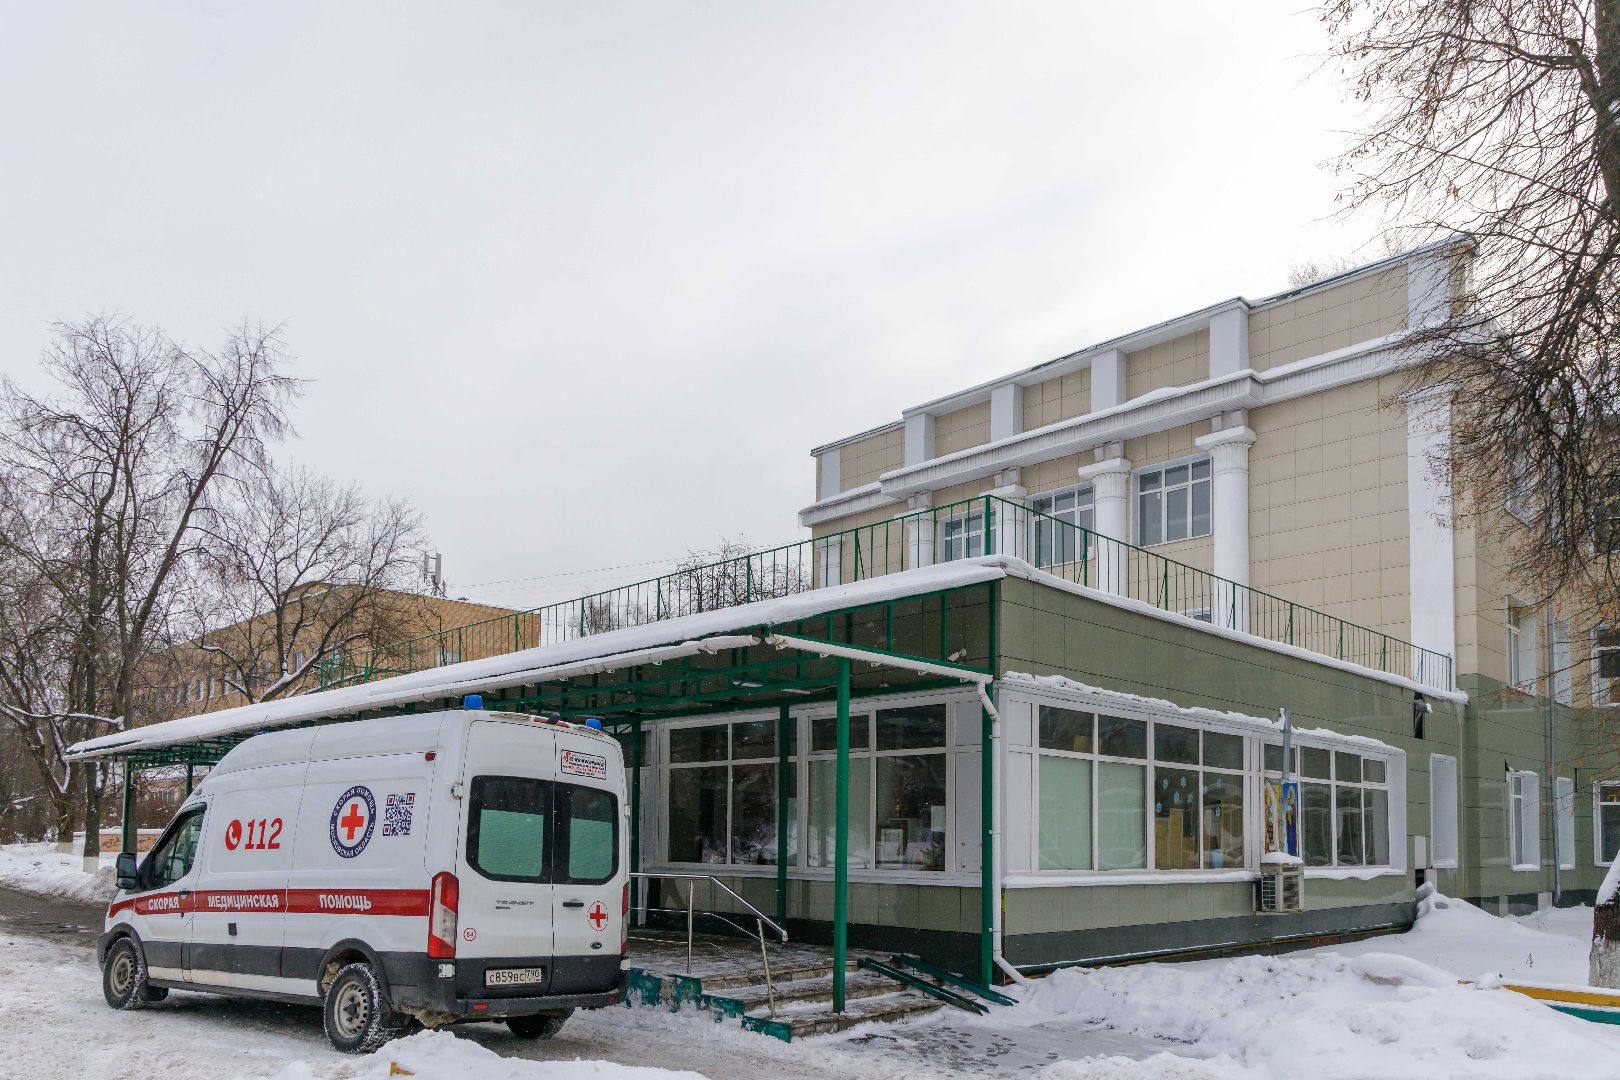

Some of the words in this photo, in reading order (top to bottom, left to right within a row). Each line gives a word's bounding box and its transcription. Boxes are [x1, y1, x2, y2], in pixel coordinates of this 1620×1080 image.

[333, 788, 355, 816] СКОРАЯ
[357, 788, 375, 814] ПОМОЩЬ
[245, 818, 283, 849] 112
[148, 896, 179, 910] СКОРАЯ
[207, 895, 279, 909] МЕДИЦИНСКАЯ
[319, 894, 371, 911] ПОМОЩЬ
